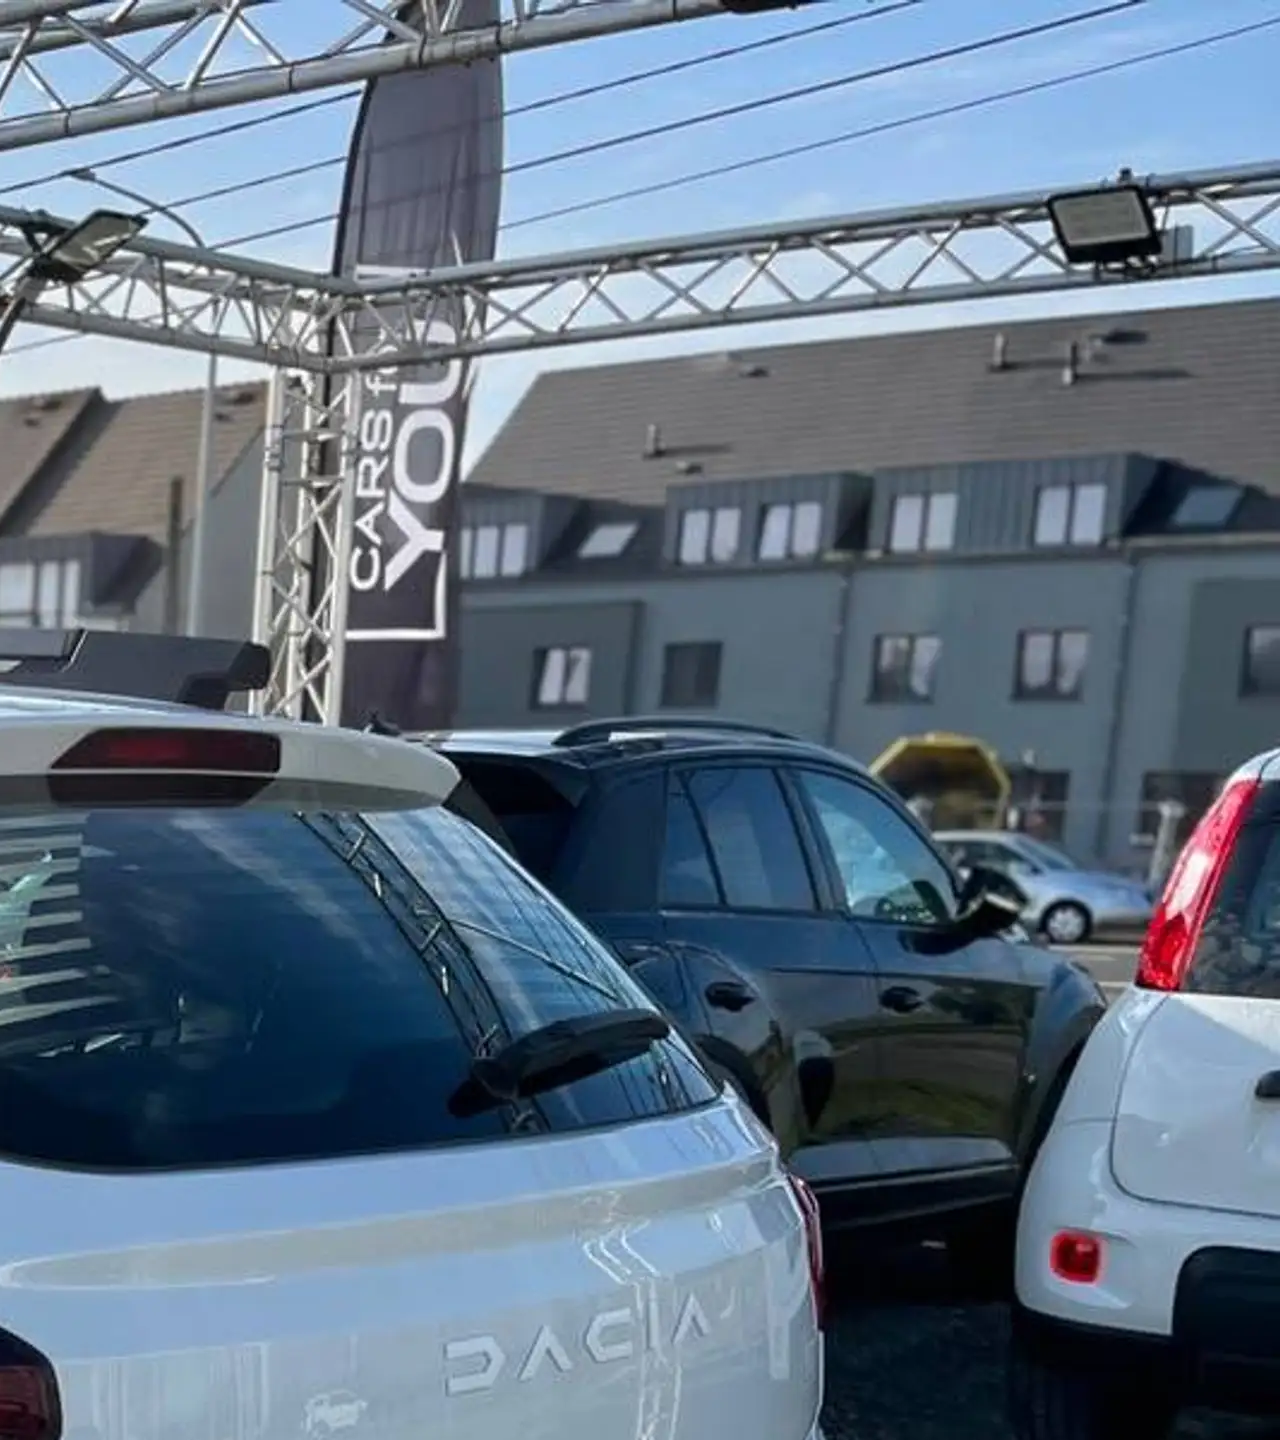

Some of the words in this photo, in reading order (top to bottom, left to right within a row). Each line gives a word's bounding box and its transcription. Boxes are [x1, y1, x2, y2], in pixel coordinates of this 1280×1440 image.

[349, 408, 393, 591] CARS
[385, 319, 462, 591] YOU
[444, 1294, 711, 1397] DACIA
